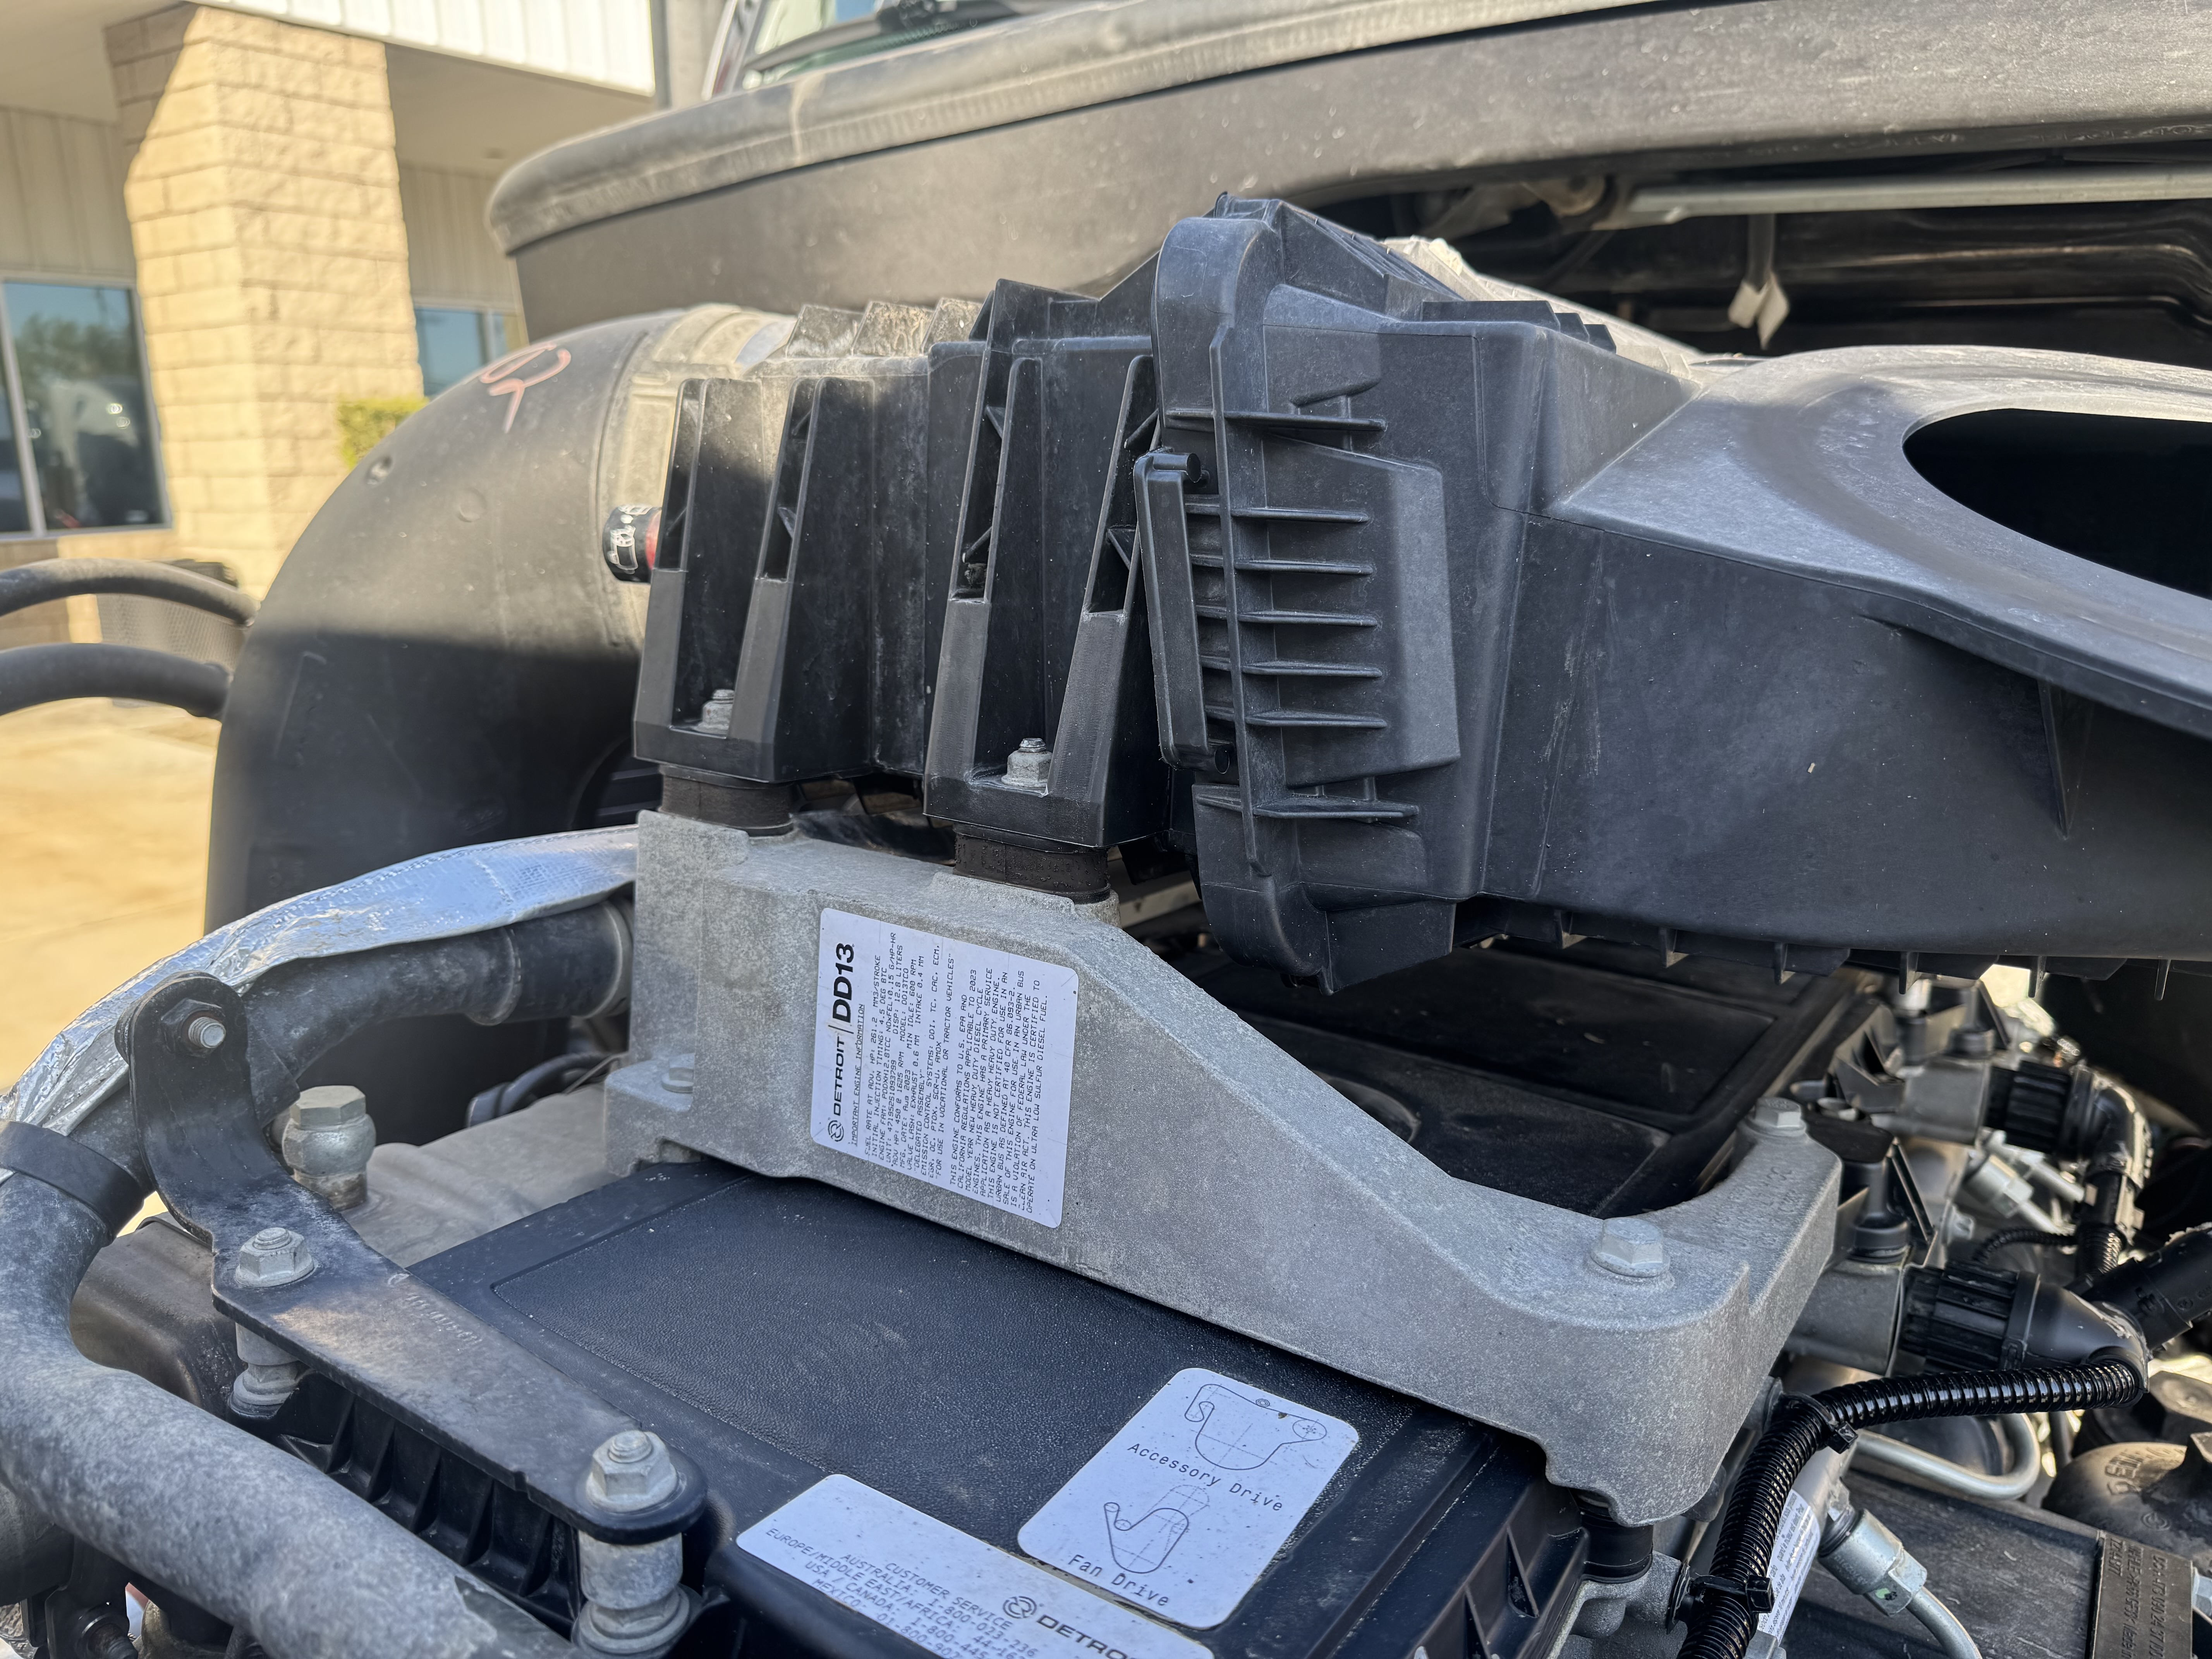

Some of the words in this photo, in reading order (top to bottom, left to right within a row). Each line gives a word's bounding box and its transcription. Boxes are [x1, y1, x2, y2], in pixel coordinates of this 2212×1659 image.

[832, 941, 854, 1023] DD13
[855, 1003, 864, 1059] INFORMATION
[939, 1064, 947, 1118] VOCATIONAL
[946, 953, 954, 1001] VEHICLES"
[1006, 986, 1015, 1035] 86.093-2.
[1030, 996, 1039, 1047] CERTIFIED
[965, 1012, 974, 1067] APPLICABLE
[833, 1036, 844, 1116] DETROIT
[994, 1048, 1003, 1097] CERTIFIED
[961, 1071, 970, 1131] REGULATIONS
[957, 1135, 966, 1188] CALIFORNIA
[980, 1137, 989, 1197] APPLICATION
[1012, 1131, 1021, 1181] VIOLATION
[1026, 1174, 1034, 1213] OPERATE
[1127, 1443, 1221, 1486] Accessory
[1229, 1483, 1282, 1511] Drive
[766, 1528, 865, 1580] EUROPE/MIDDLE
[865, 1578, 960, 1633] EAST/AFRICA:
[805, 1561, 829, 1577] USA
[846, 1582, 901, 1614] CANADA:
[812, 1579, 867, 1610] MEXICO:
[840, 1554, 918, 1596] AUSTRALIA:
[928, 1598, 1039, 1657] 1-800-023-236
[885, 1563, 950, 1599] CUSTOMER
[952, 1597, 1013, 1630] SERVICE
[1068, 1554, 1103, 1577] Fan
[1111, 1573, 1169, 1606] Drive
[1036, 1614, 1138, 1659] DETRO
